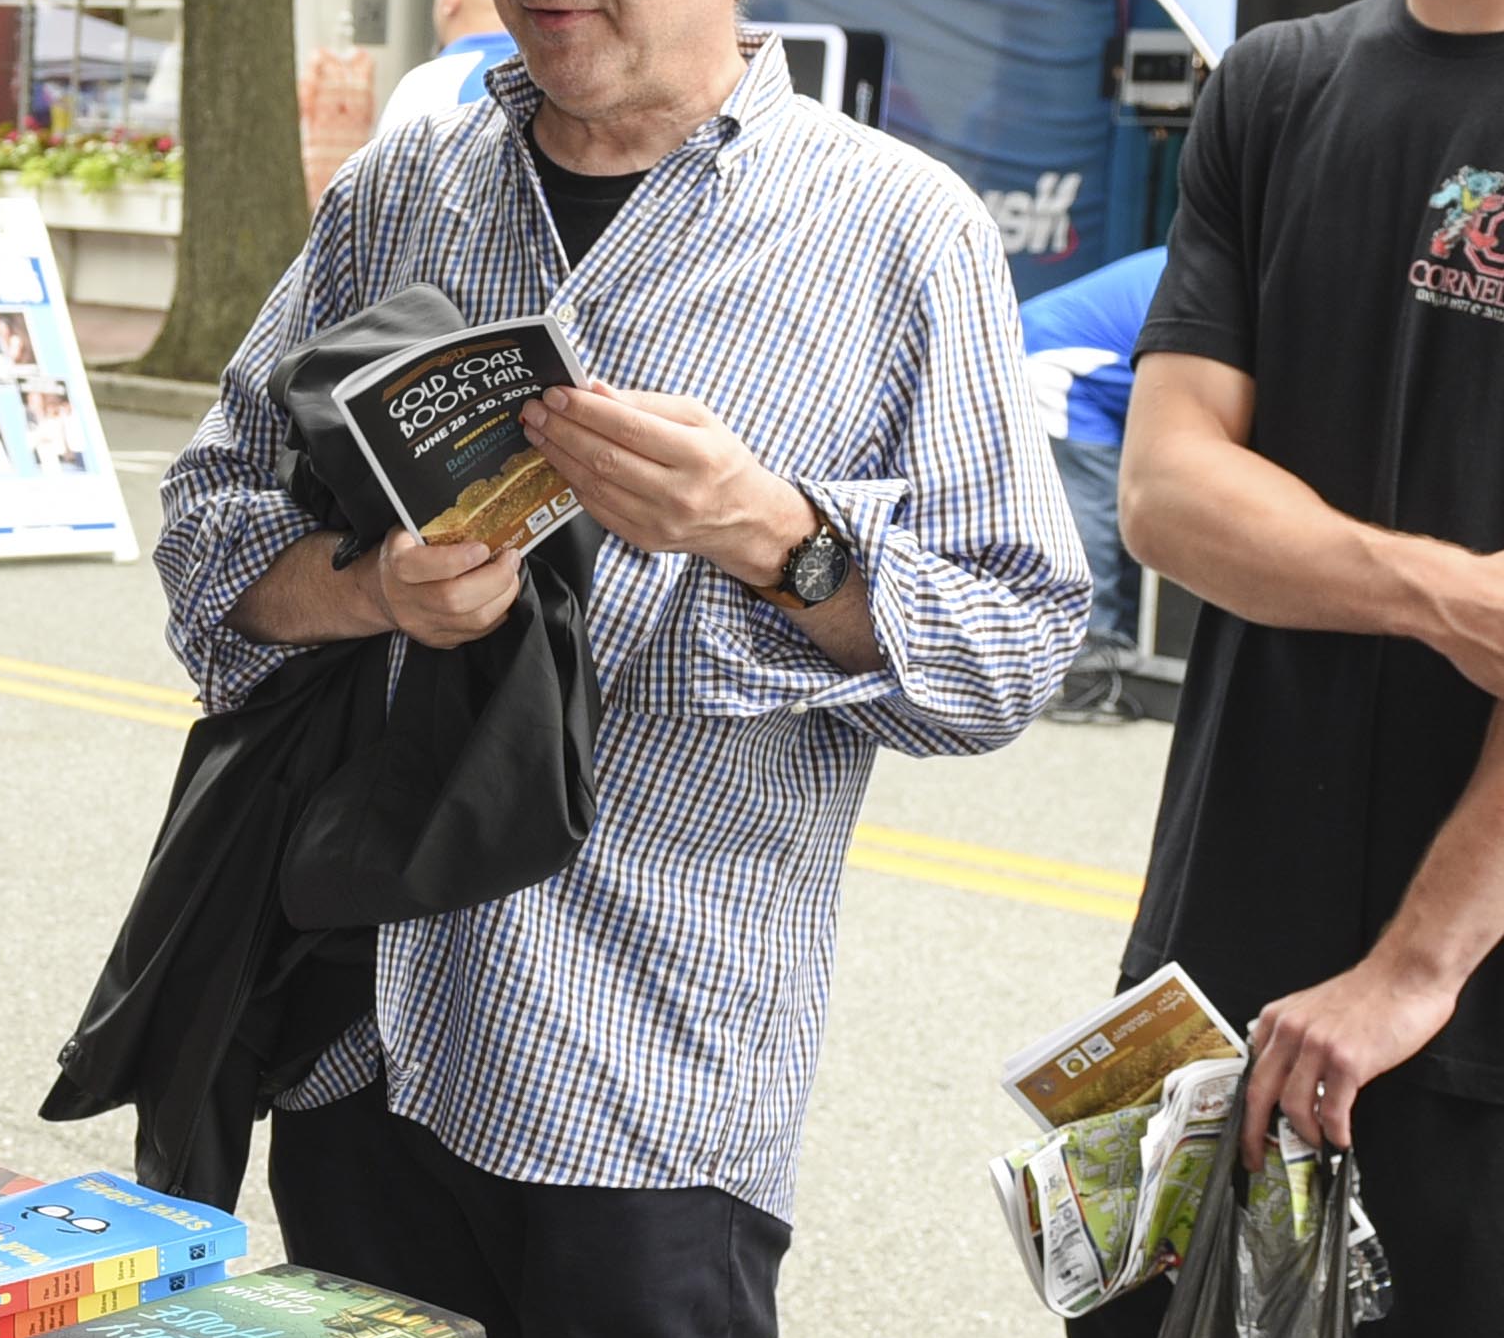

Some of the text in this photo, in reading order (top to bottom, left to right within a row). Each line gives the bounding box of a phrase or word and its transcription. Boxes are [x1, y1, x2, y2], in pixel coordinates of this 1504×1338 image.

[388, 349, 524, 420] GOLD COAST
[399, 366, 534, 440] BOOK FAIR
[412, 425, 450, 459] JUNE
[450, 414, 468, 433] 28
[476, 399, 502, 413] 30,
[502, 383, 541, 403] 2024
[446, 421, 515, 472] Bethpage
[453, 412, 510, 450] PRESENTED BY
